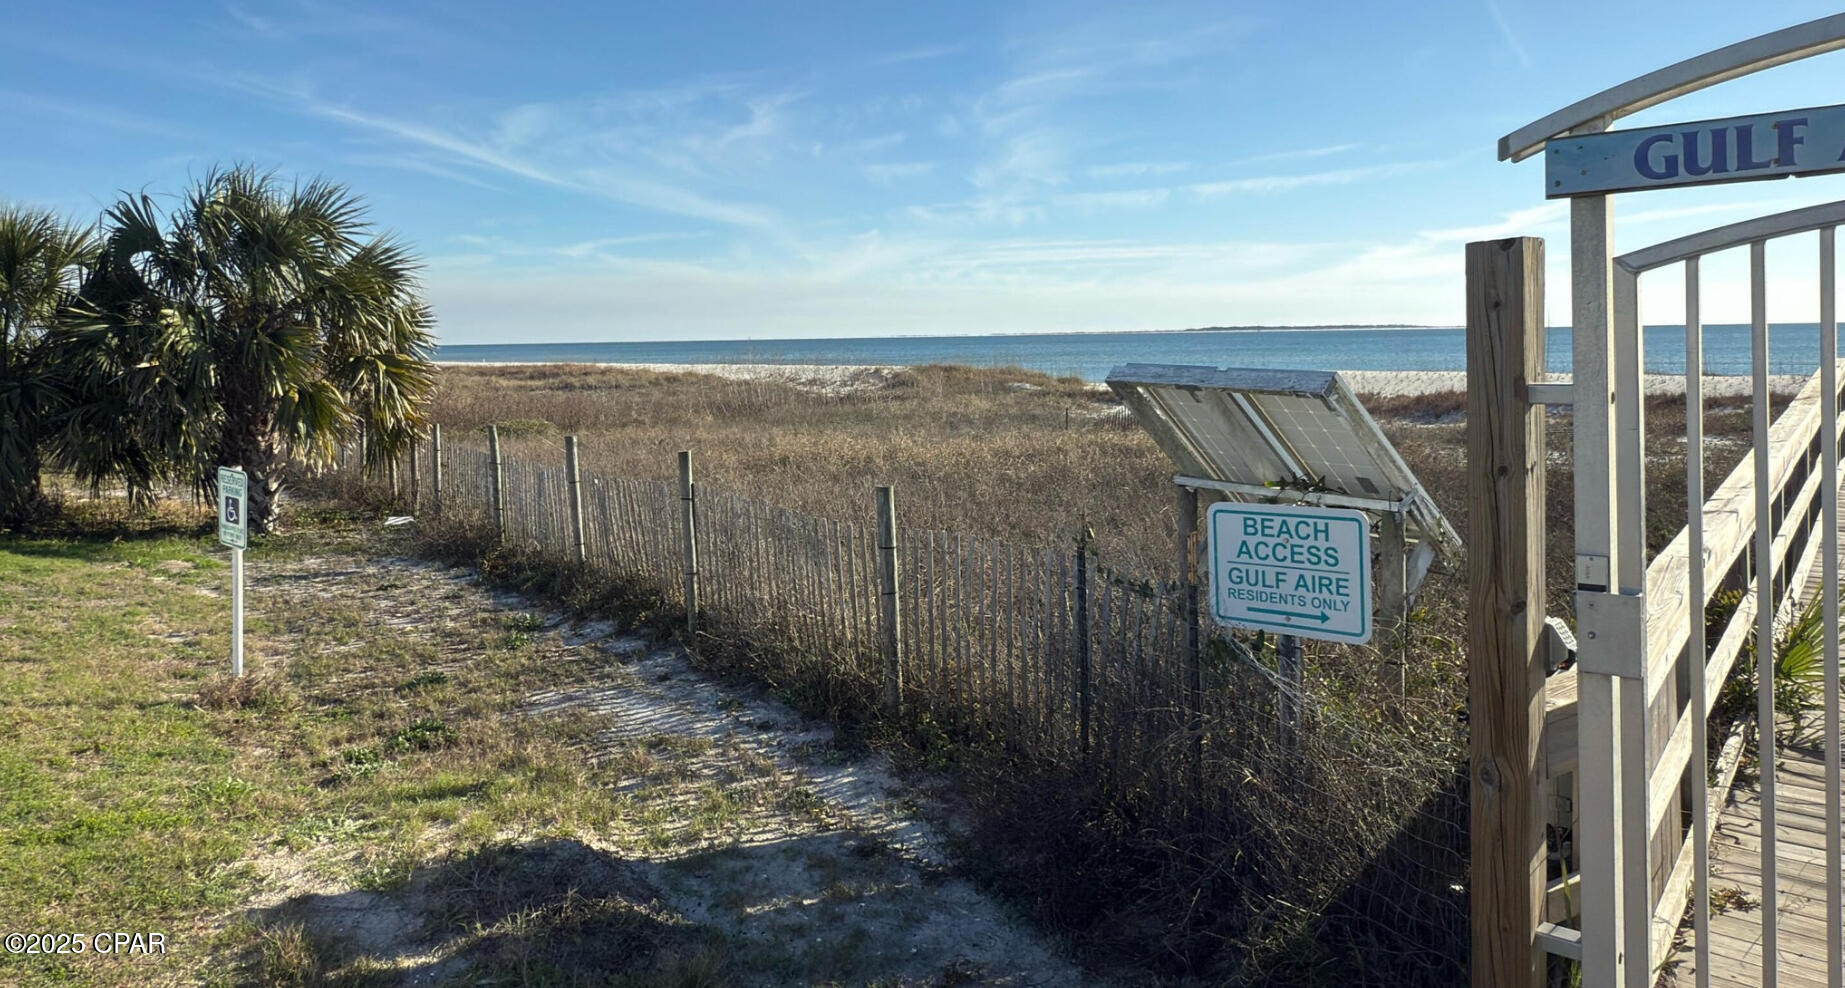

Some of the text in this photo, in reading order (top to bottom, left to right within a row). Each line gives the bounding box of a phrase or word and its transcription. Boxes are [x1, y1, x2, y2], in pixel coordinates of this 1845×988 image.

[1634, 118, 1808, 180] GULF
[221, 474, 244, 488] RESERVED
[222, 485, 243, 498] PARKING
[1243, 517, 1330, 542] BEACH
[1236, 540, 1340, 567] ACCESS
[1228, 567, 1350, 598] GULF AIRE
[1227, 588, 1351, 613] RESIDENTS ONLY
